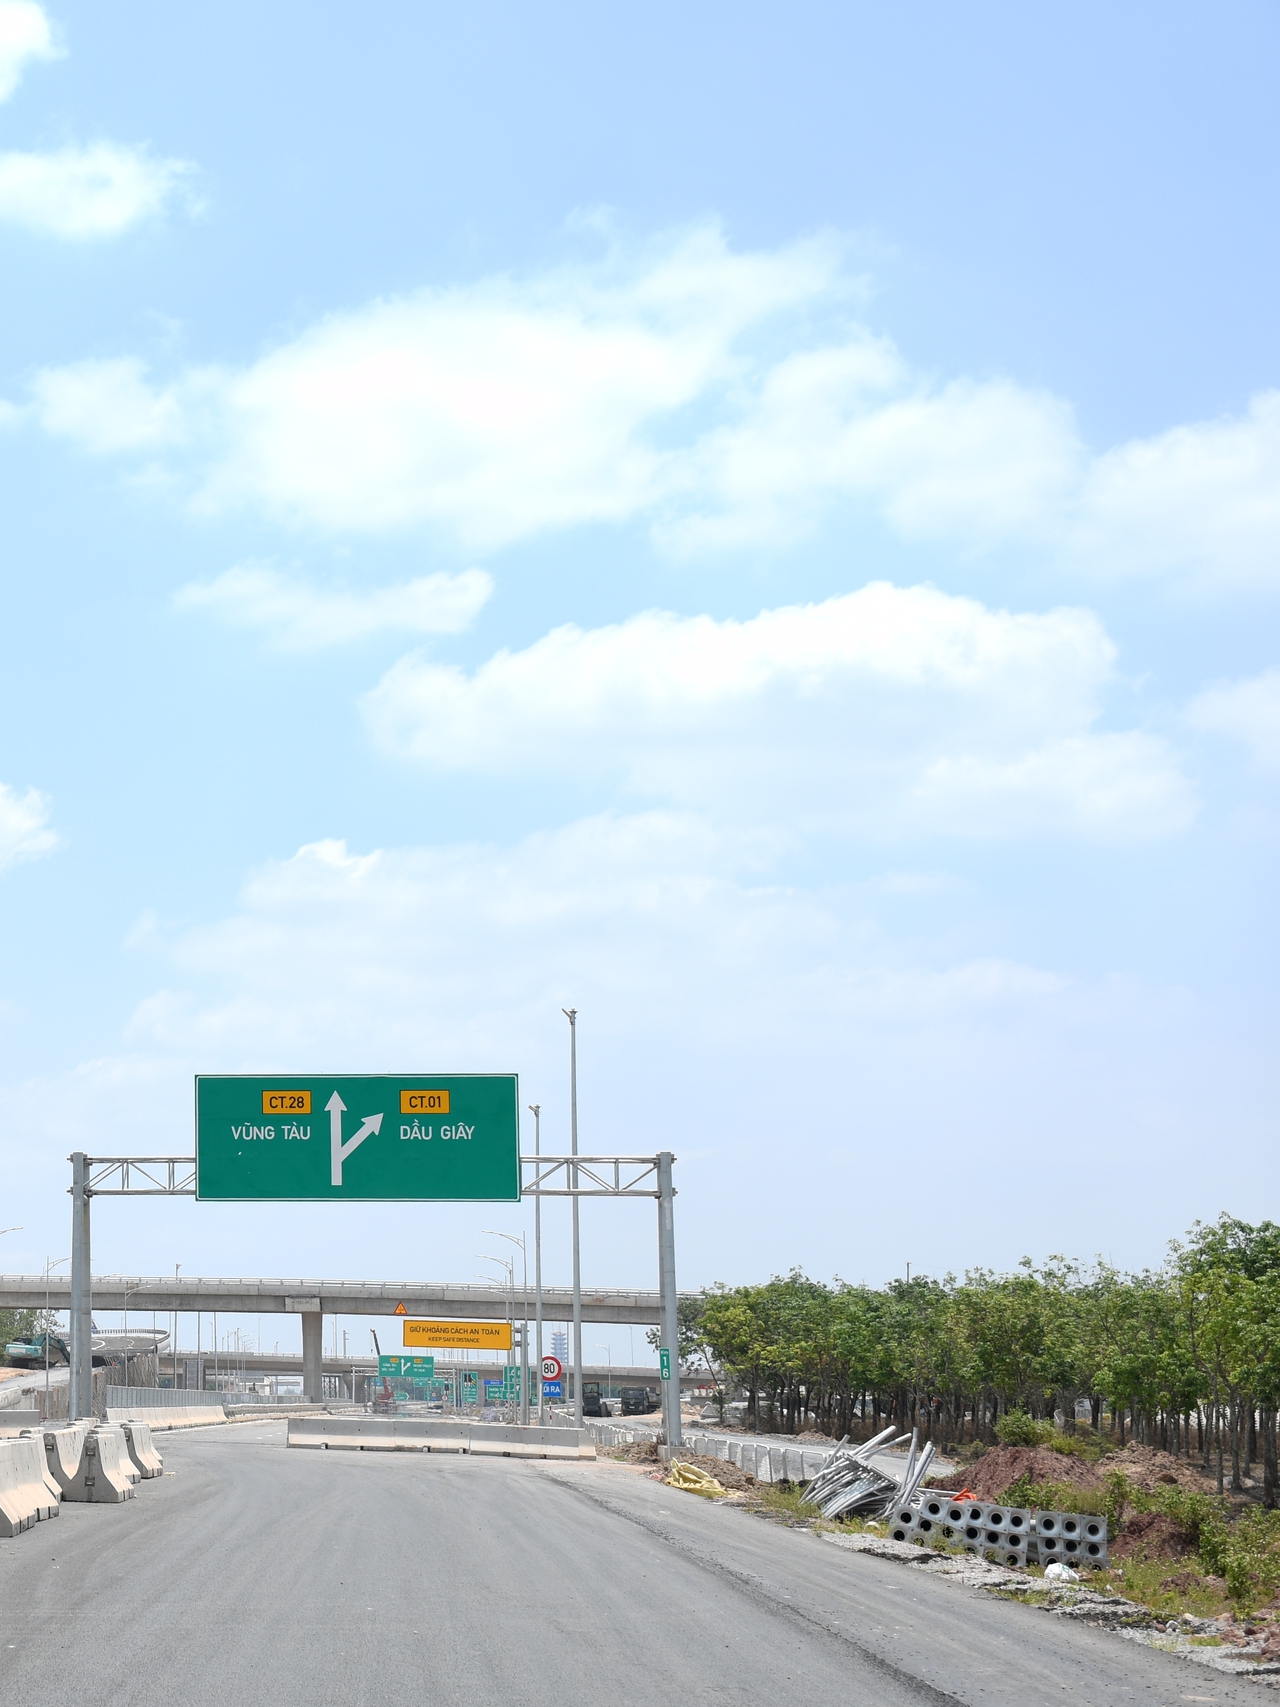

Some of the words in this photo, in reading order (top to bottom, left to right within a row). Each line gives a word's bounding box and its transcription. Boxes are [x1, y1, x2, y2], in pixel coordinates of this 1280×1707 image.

[269, 1096, 305, 1109] CT.28
[408, 1095, 442, 1109] CT.01
[231, 1122, 275, 1140] VŨNG
[281, 1121, 311, 1140] TÀU
[399, 1119, 433, 1140] DẦU
[440, 1122, 476, 1140] GIÂY
[450, 1326, 468, 1335] CÁCH
[481, 1327, 500, 1336] TOÀN
[543, 1363, 555, 1374] 80
[550, 1385, 560, 1393] RA
